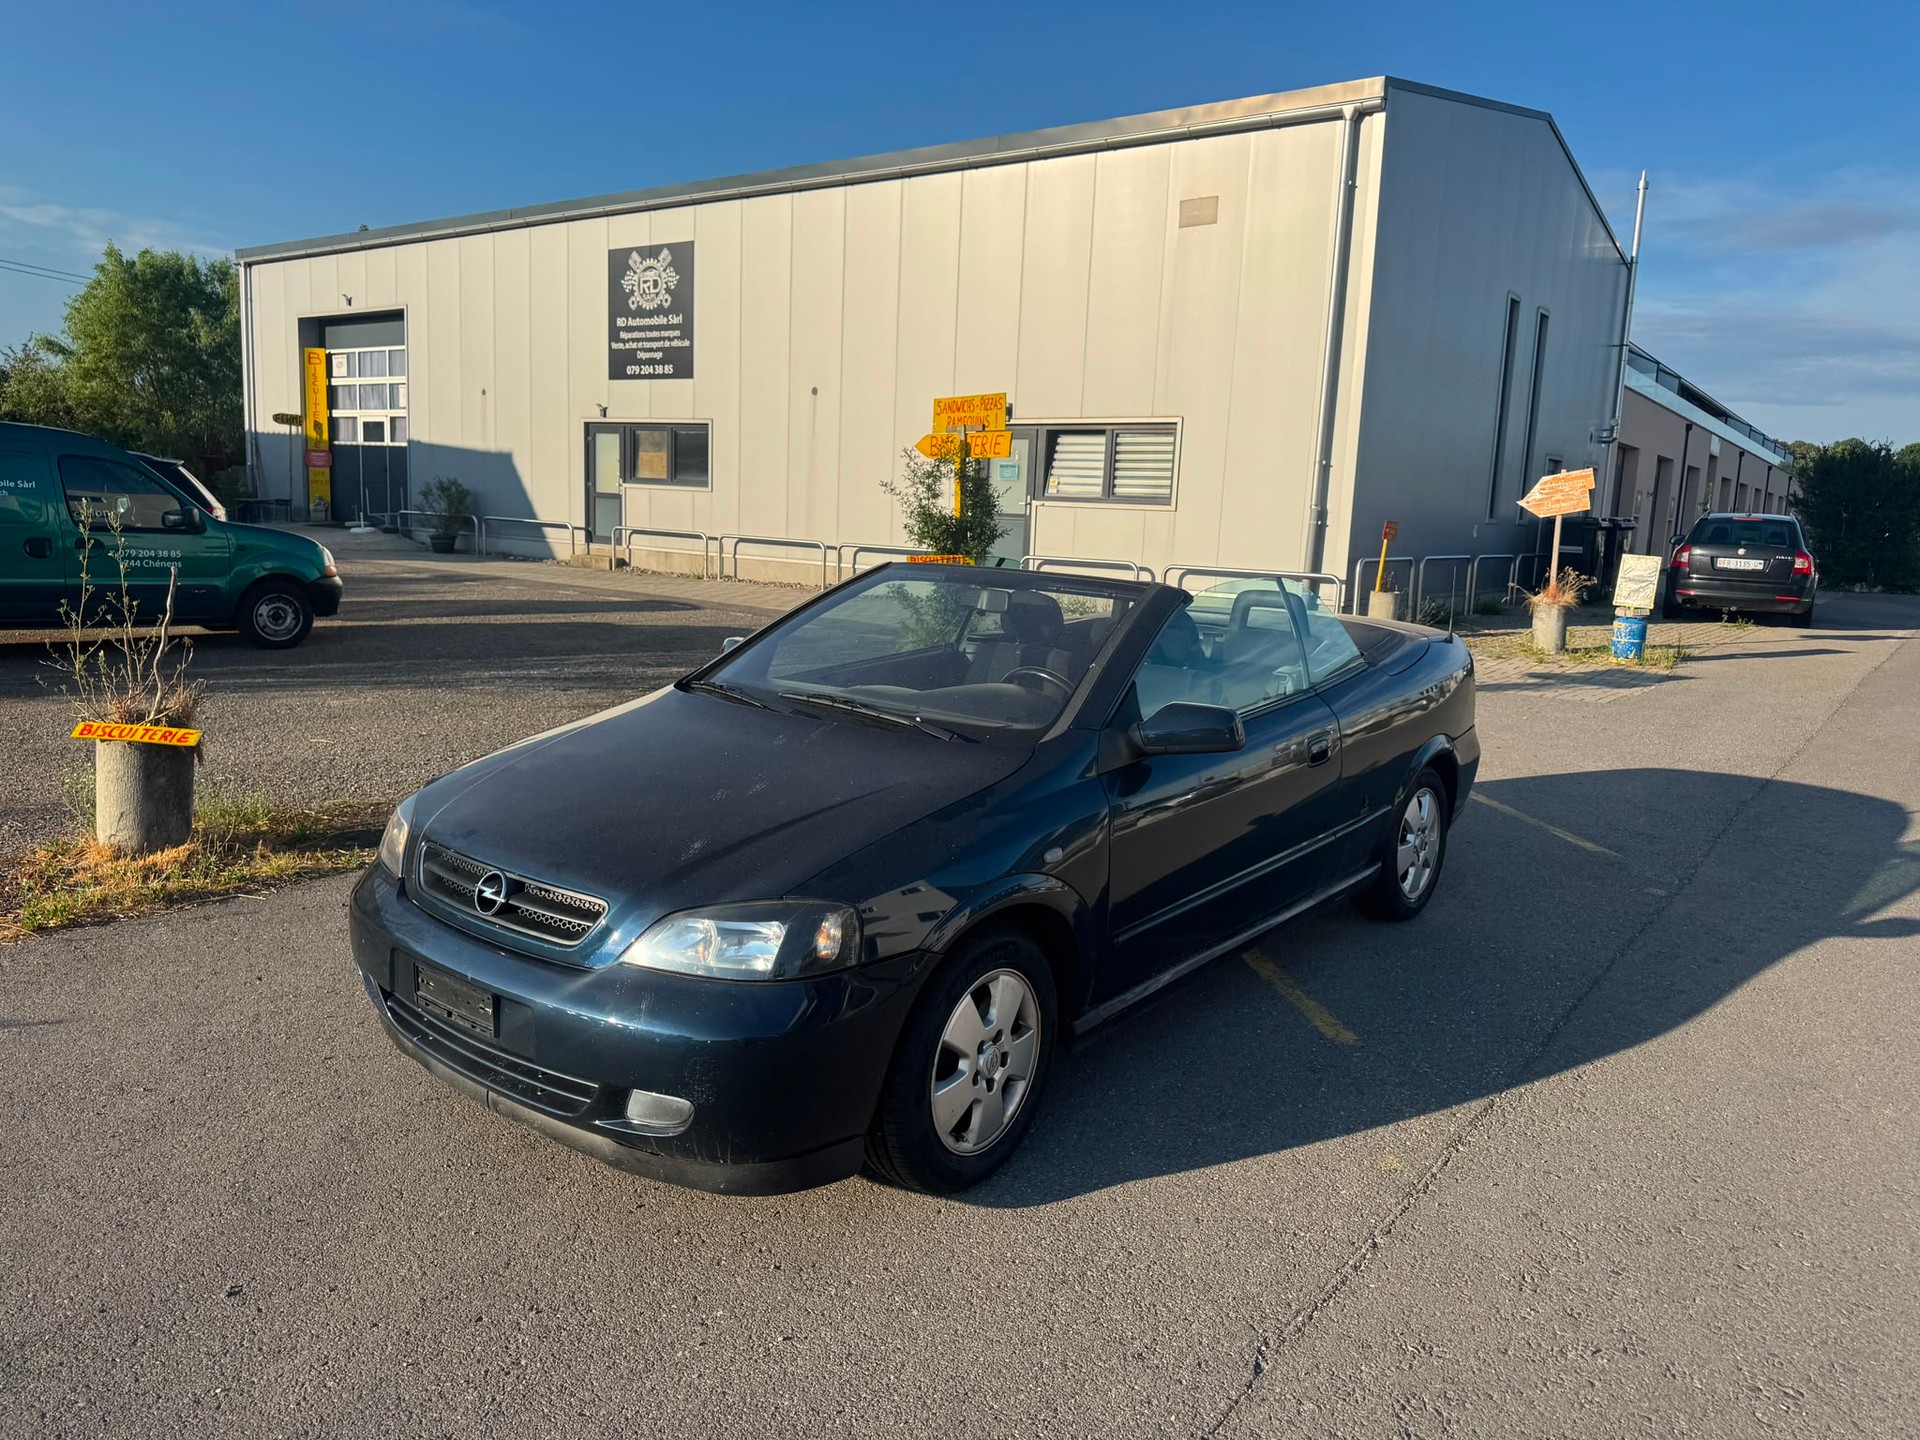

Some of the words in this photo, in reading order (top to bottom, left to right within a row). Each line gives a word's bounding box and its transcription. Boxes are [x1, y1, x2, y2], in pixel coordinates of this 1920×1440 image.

[616, 317, 627, 327] RD
[627, 314, 667, 327] Automobile
[646, 330, 660, 338] toutes
[660, 330, 681, 339] marques
[625, 340, 638, 349] achat
[643, 340, 664, 350] transport
[664, 339, 671, 348] de
[636, 350, 664, 360] Dépannage
[626, 365, 640, 375] 079
[640, 364, 654, 375] 204
[654, 364, 664, 375] 38
[664, 364, 674, 374] 85
[980, 396, 1003, 412] PIZZAS
[929, 434, 1005, 457] BTERIE
[138, 549, 155, 558] 204
[157, 549, 169, 558] 38
[170, 550, 182, 558] 85
[121, 560, 141, 568] 744
[143, 559, 182, 568] Chénens
[78, 723, 196, 743] BISCUITERIE
